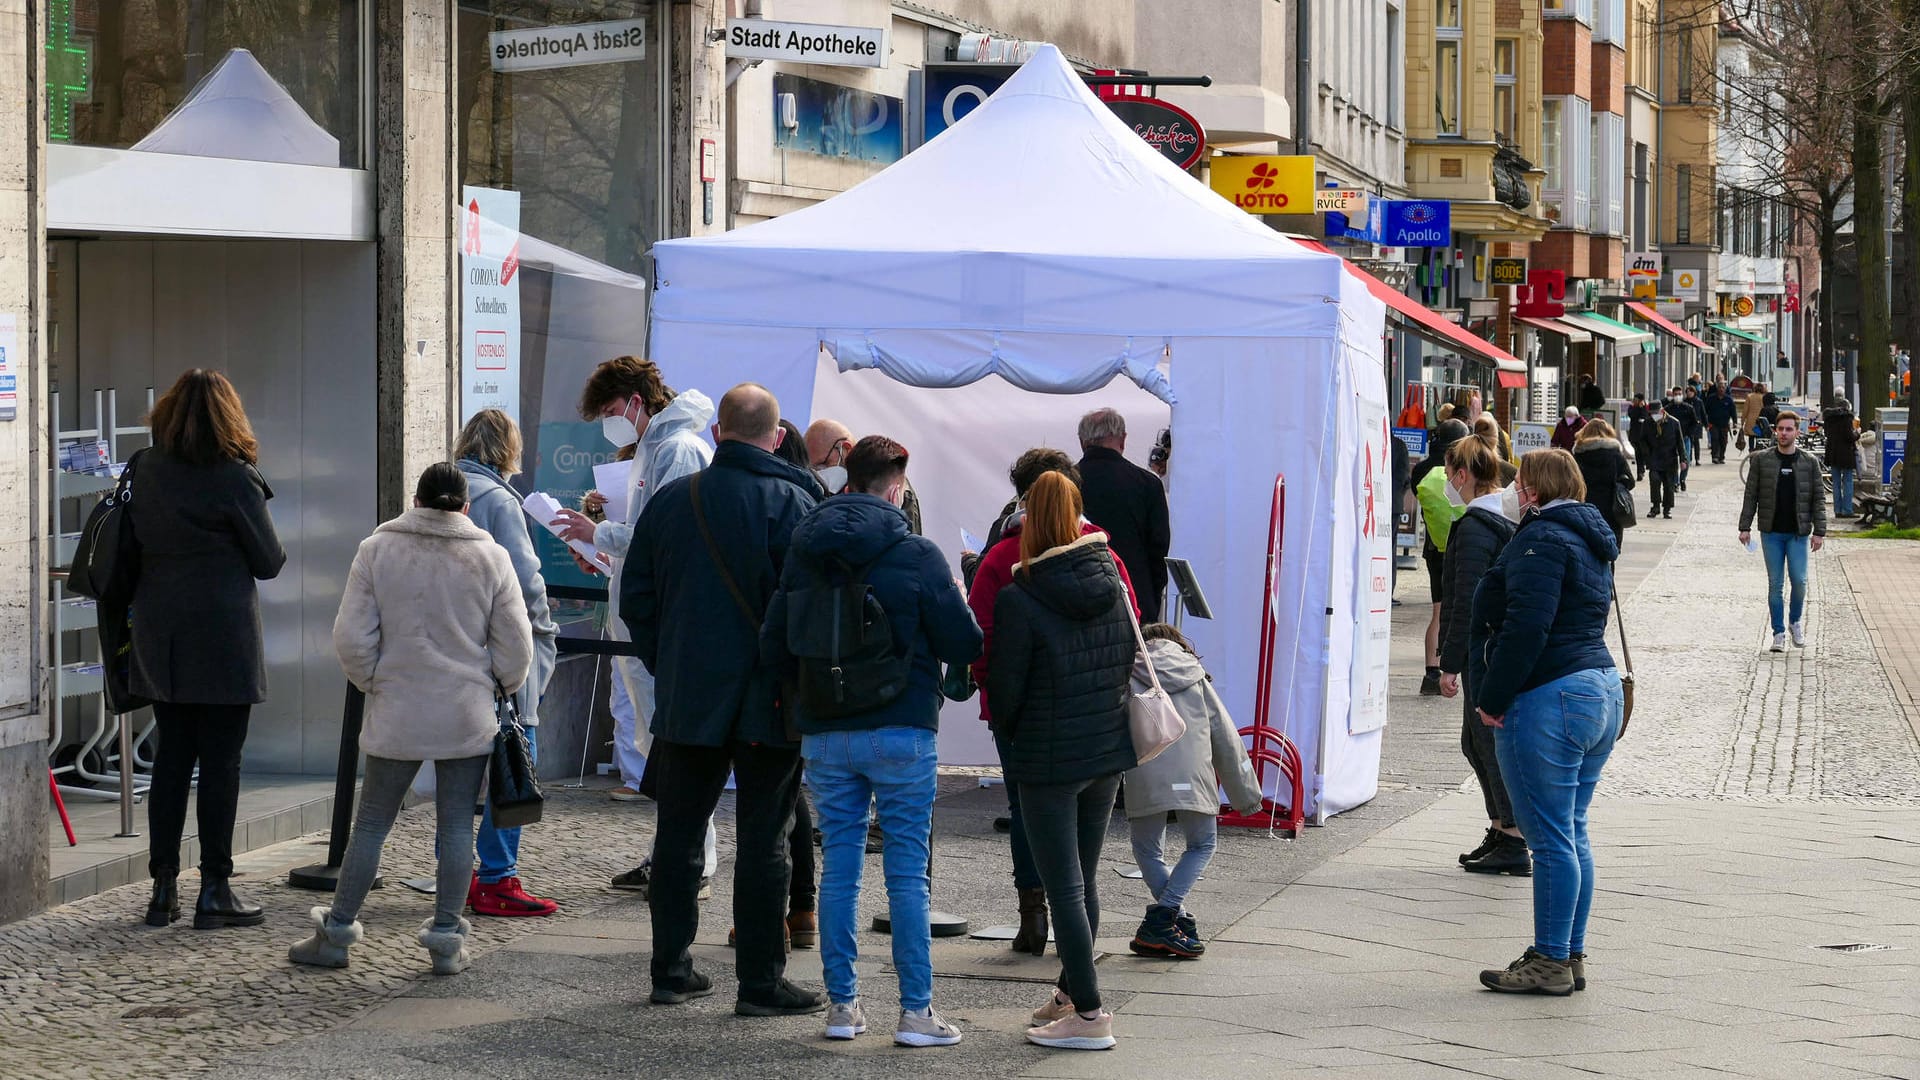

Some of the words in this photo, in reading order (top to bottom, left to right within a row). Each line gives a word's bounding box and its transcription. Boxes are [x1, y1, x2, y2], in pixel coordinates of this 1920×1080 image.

[731, 26, 781, 49] Stadt
[785, 30, 877, 56] Apotheke
[1235, 193, 1289, 208] LOTTO
[1397, 228, 1441, 244] Apollo
[1633, 256, 1655, 270] dm
[470, 267, 498, 286] CORONA
[1494, 265, 1522, 279] BODE
[477, 344, 505, 358] KOSTENLOS
[1518, 431, 1546, 440] PASS-
[1518, 439, 1546, 447] BILDER
